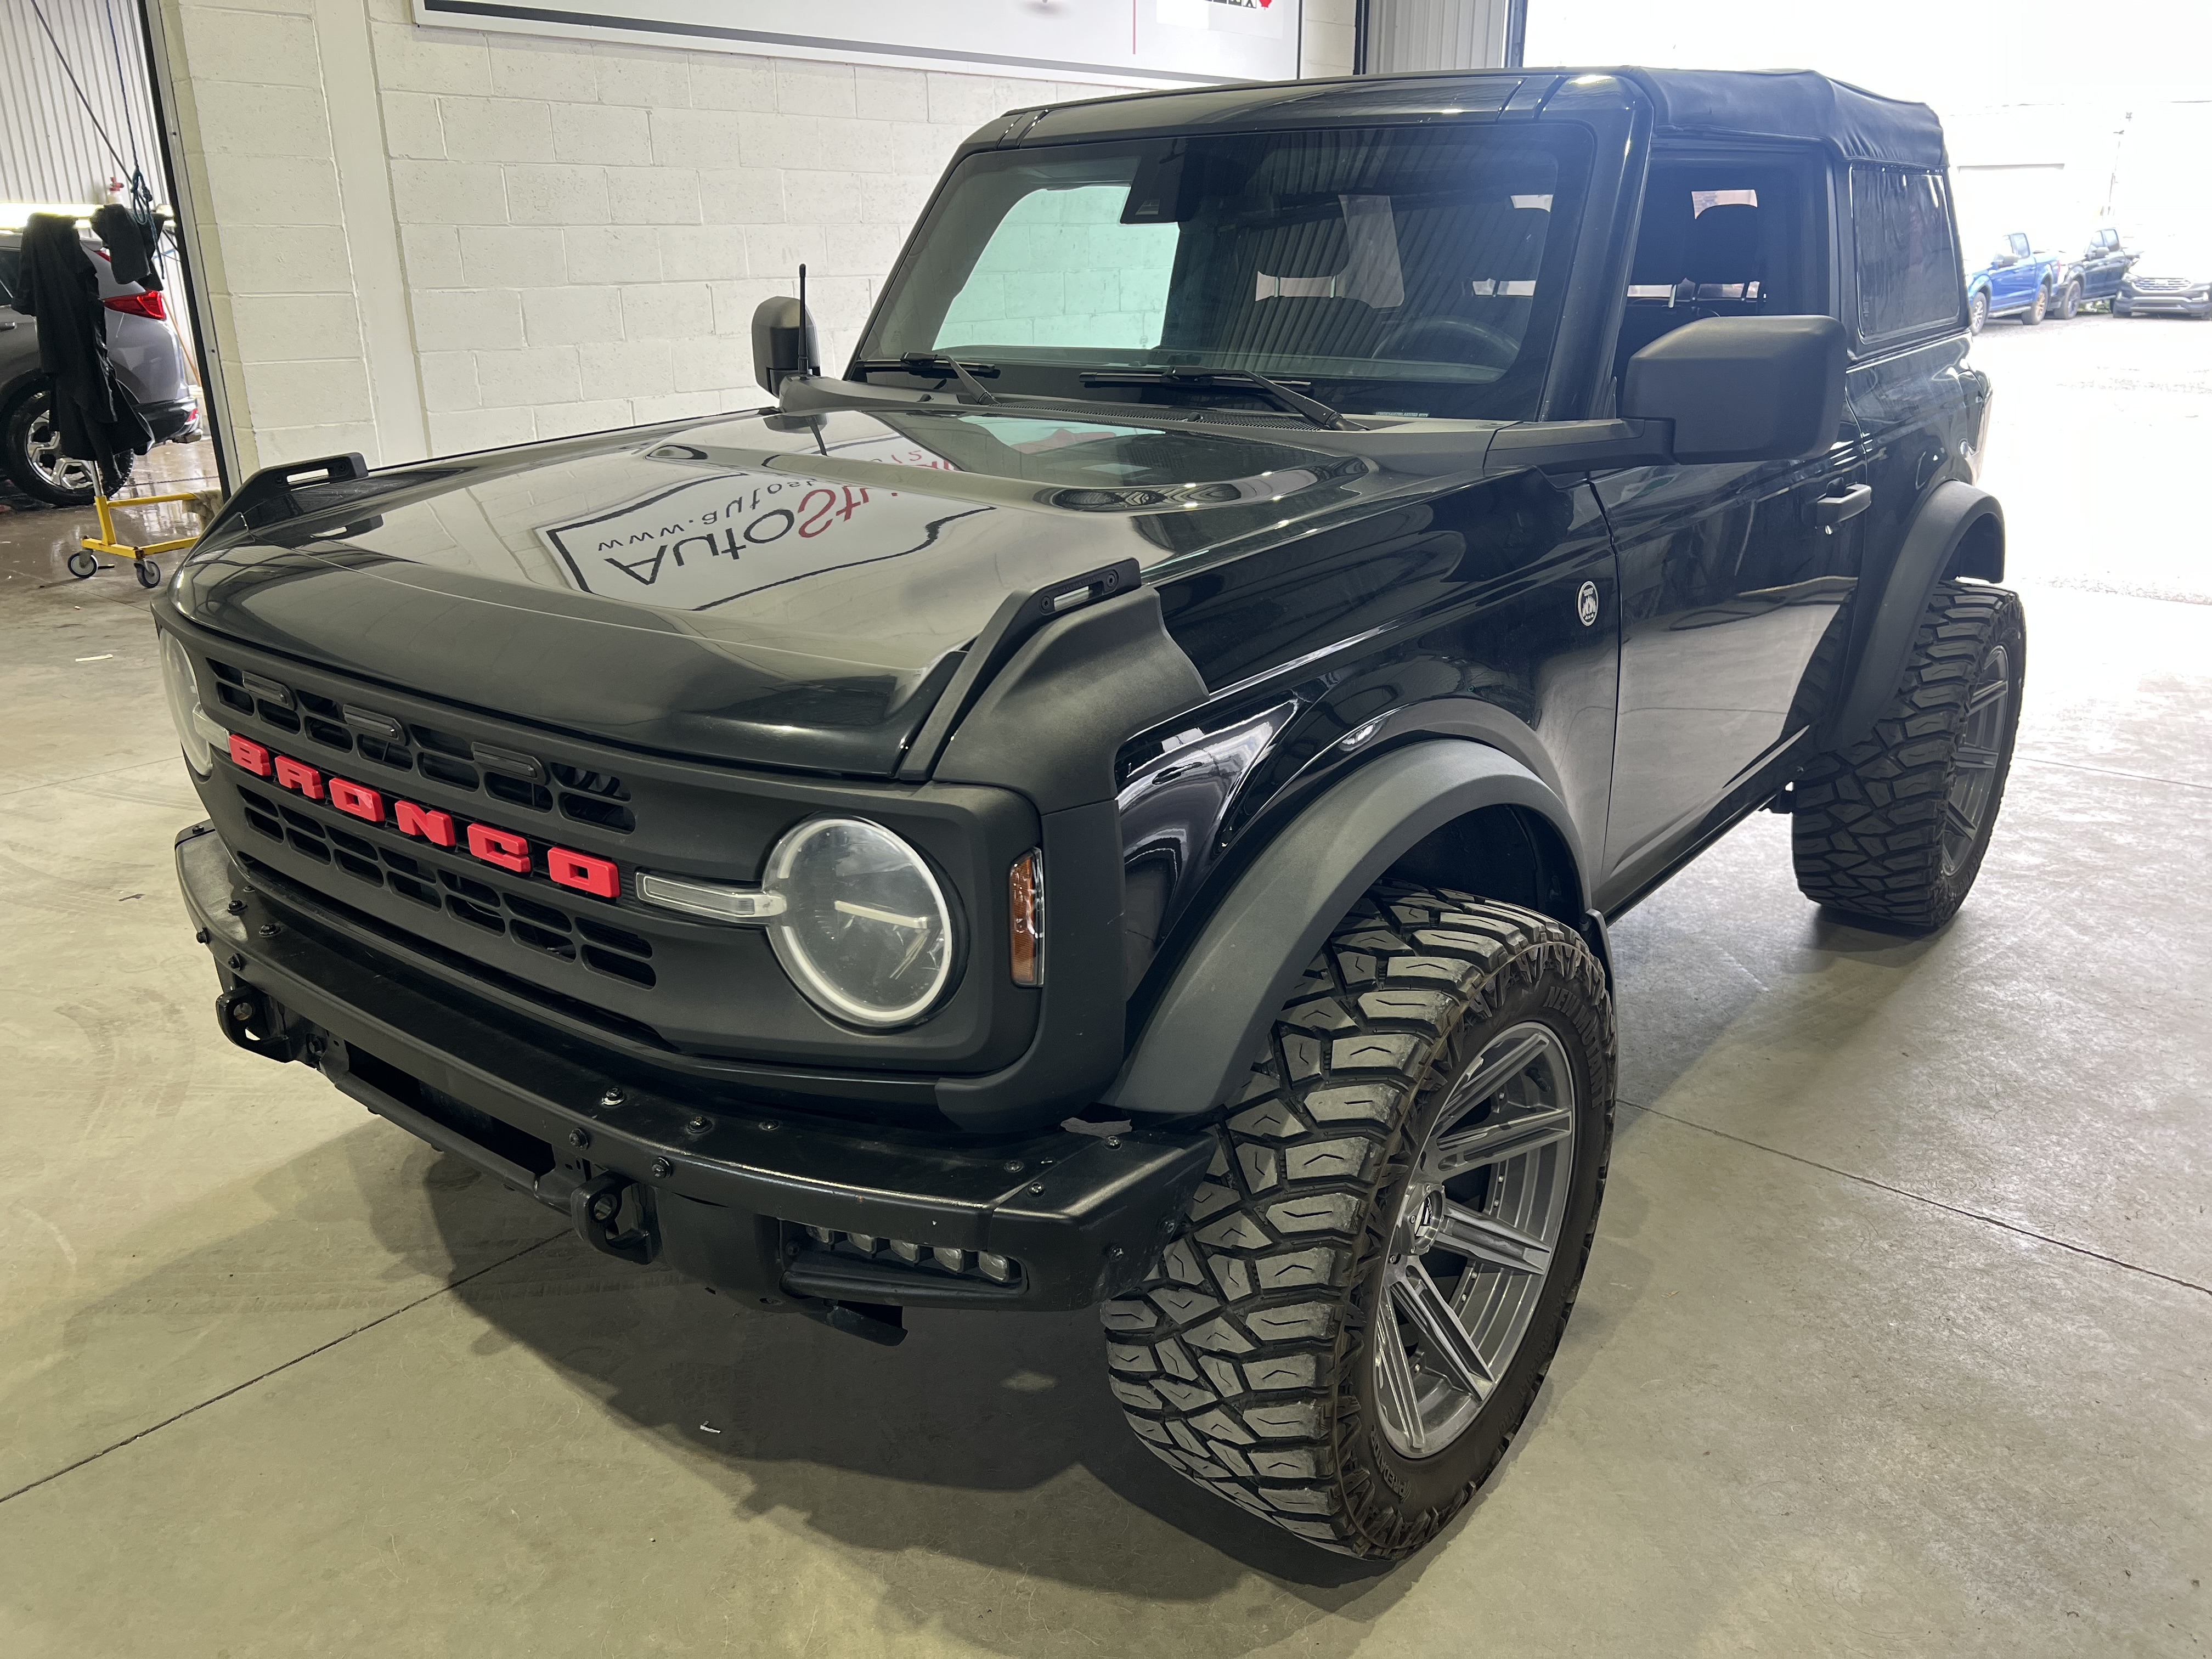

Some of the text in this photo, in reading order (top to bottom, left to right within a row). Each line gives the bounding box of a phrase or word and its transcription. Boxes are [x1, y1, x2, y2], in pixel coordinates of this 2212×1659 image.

[228, 732, 620, 898] BRONCO
[1543, 986, 1604, 1109] NEW MUTANT
[1370, 1423, 1412, 1503] PREDATOR
